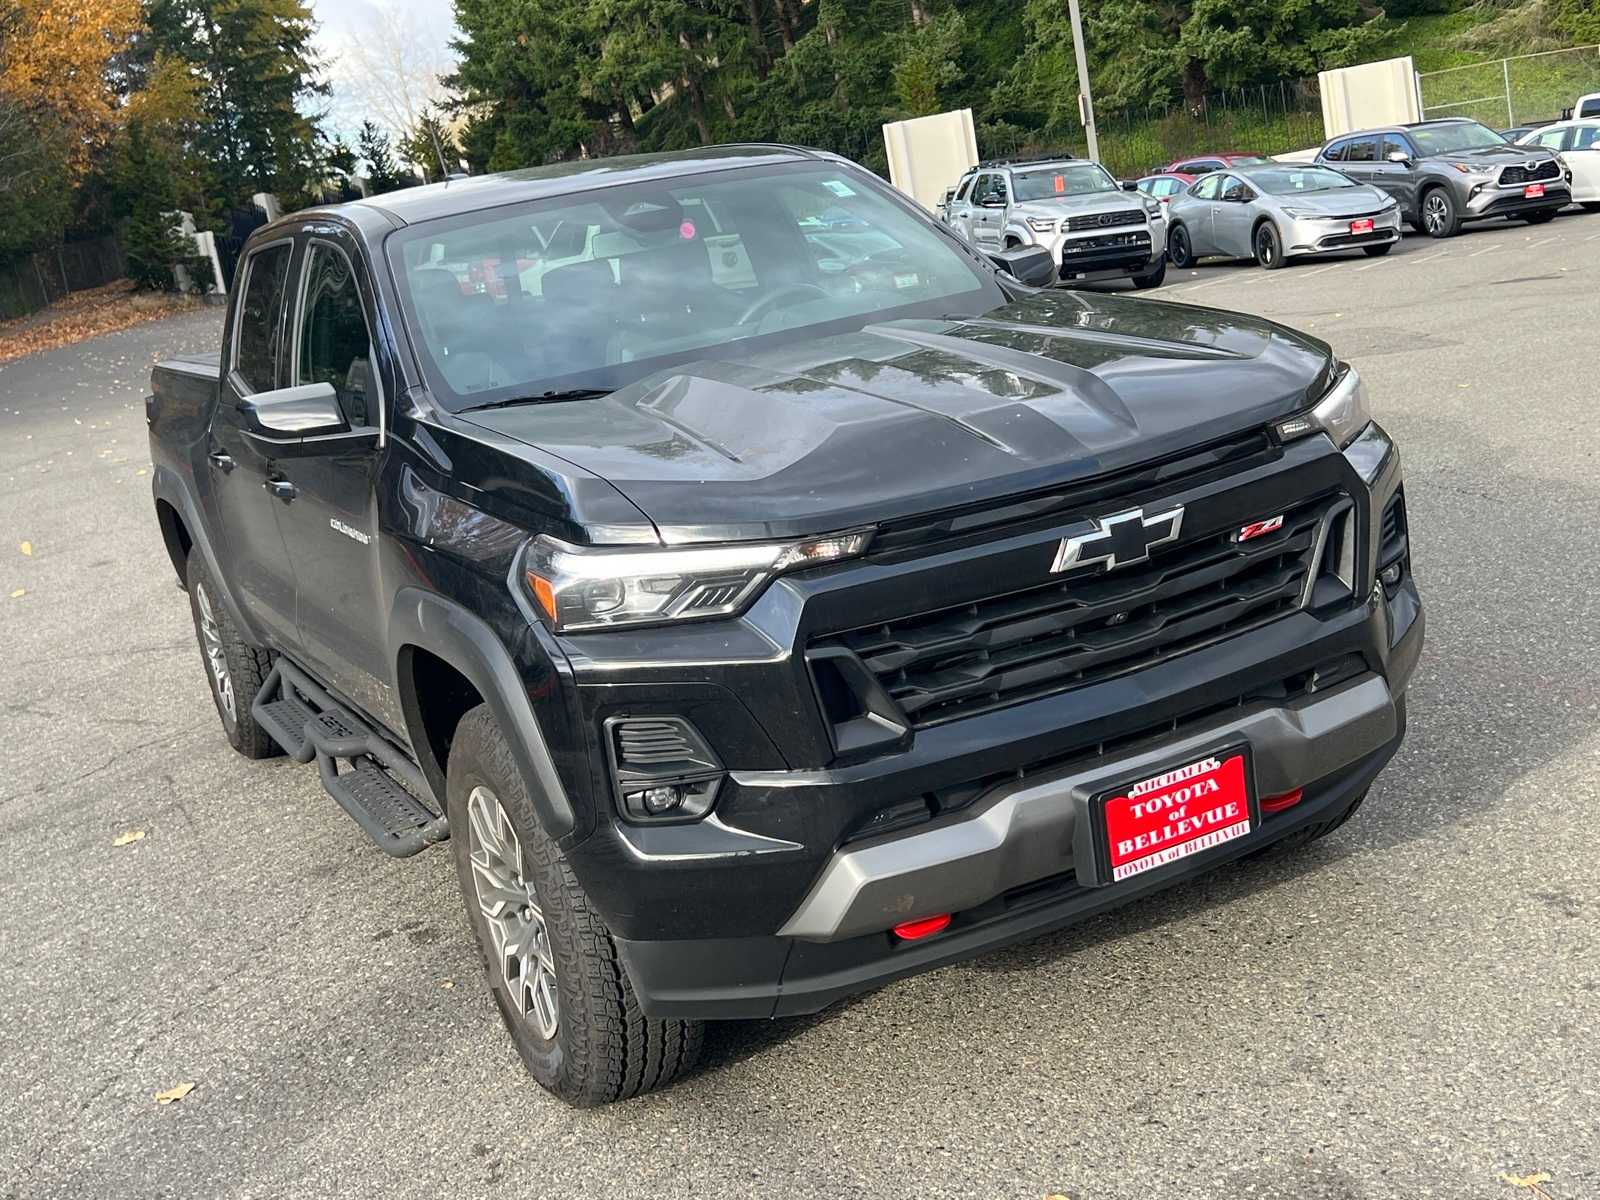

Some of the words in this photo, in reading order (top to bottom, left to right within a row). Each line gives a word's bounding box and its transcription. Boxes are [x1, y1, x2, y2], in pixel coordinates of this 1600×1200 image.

[1130, 778, 1219, 819] TOYOTA
[1168, 805, 1187, 821] of
[1117, 801, 1239, 856] BELLEVUE
[1117, 854, 1165, 878] TOYOTA
[1168, 848, 1181, 860] of
[1185, 823, 1247, 854] BELLEVUE
